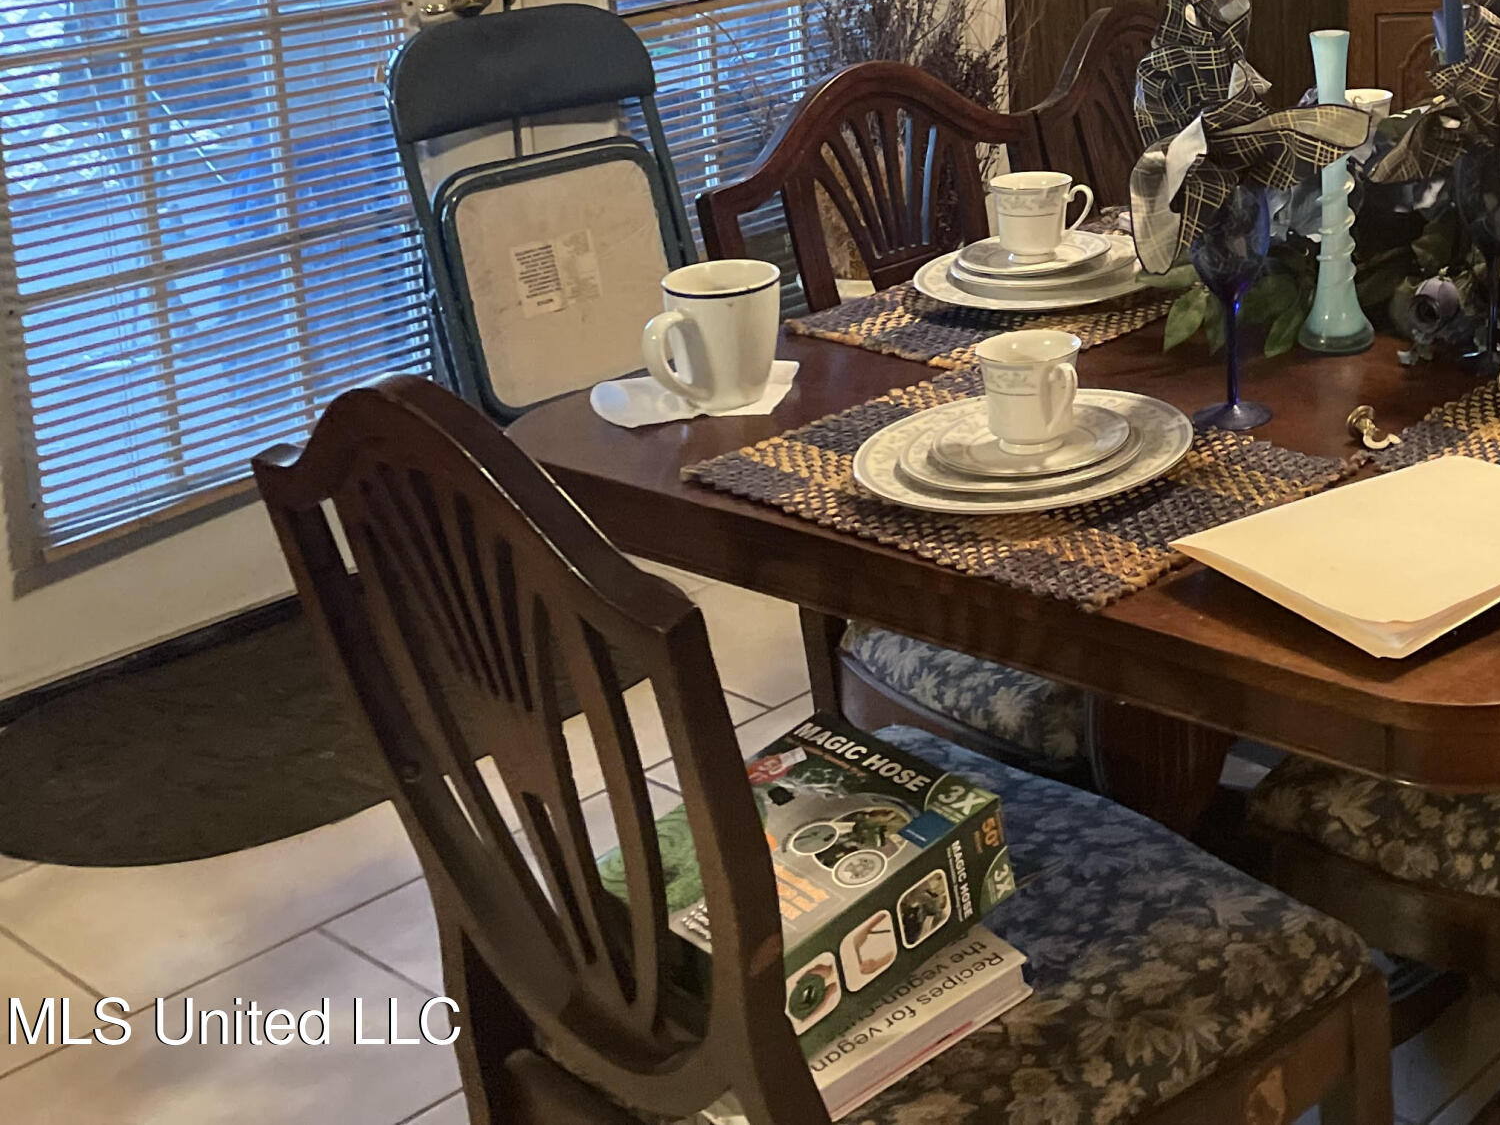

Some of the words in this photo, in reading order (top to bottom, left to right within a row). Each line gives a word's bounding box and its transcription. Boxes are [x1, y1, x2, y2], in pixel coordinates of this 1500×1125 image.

[793, 722, 868, 761] MAGIC
[861, 753, 932, 792] HOSE
[937, 785, 986, 816] 3X
[951, 839, 968, 883] MAGIC
[994, 863, 1012, 900] 3X
[959, 883, 974, 920] HOSE
[950, 940, 988, 964] the
[916, 951, 1005, 1006] Recipes
[886, 1004, 917, 1029] for
[811, 1025, 883, 1072] vegan
